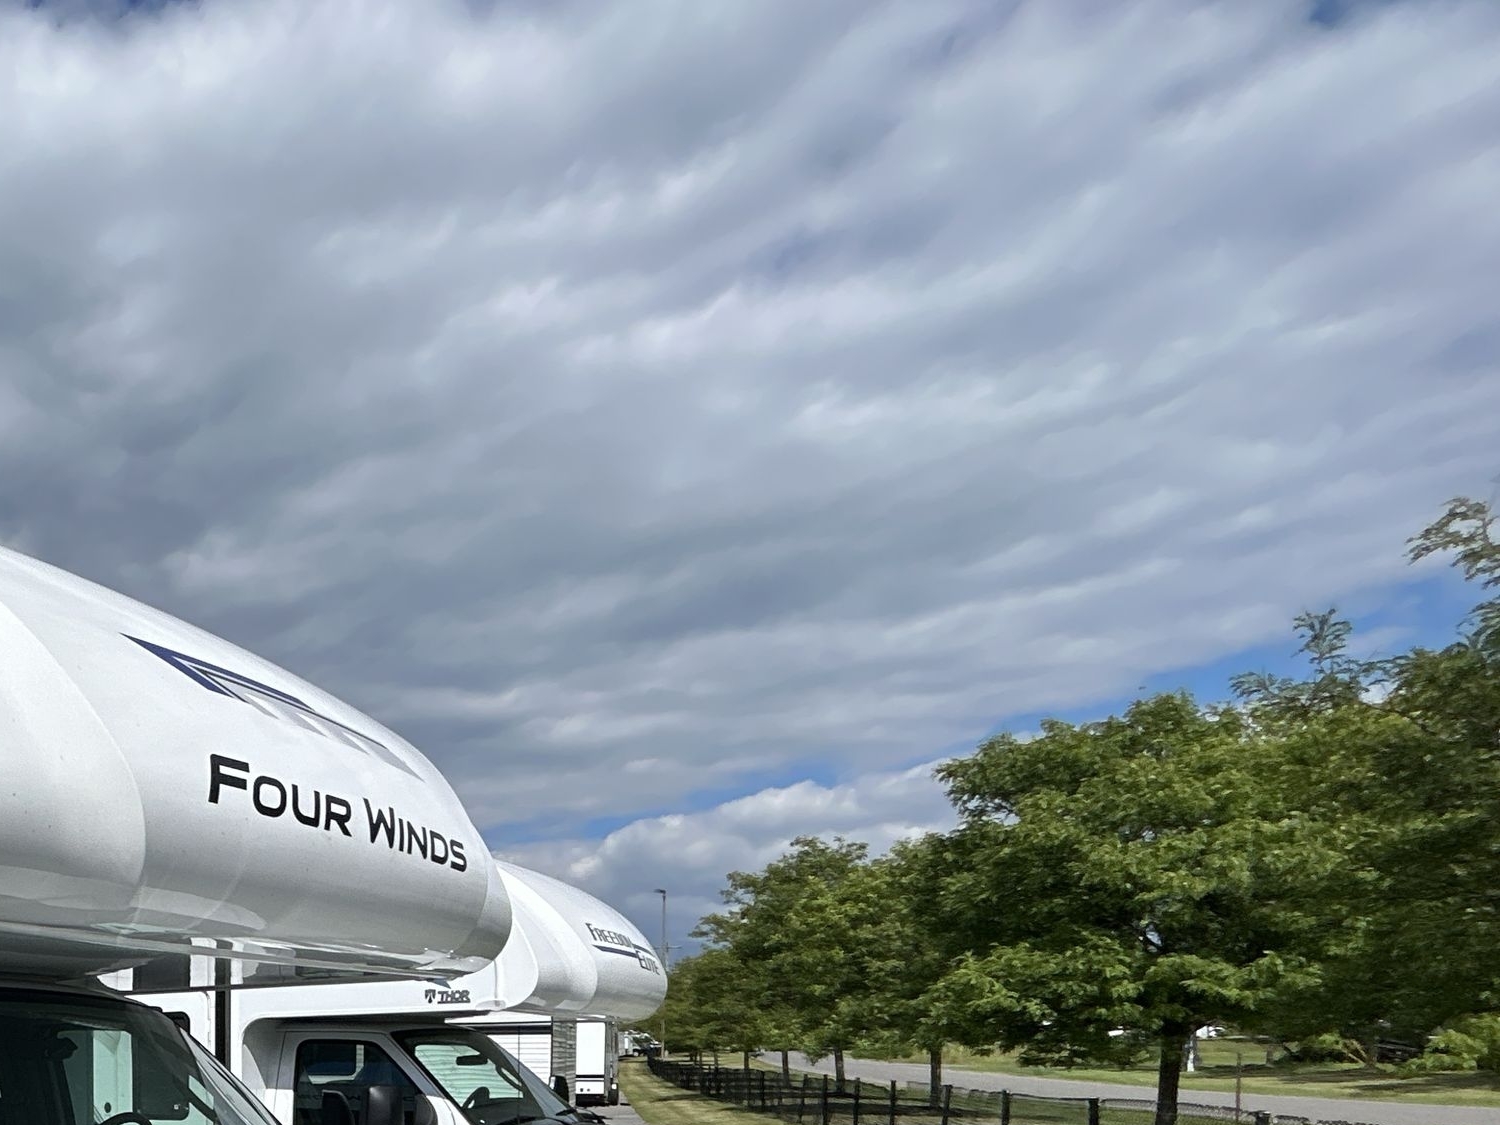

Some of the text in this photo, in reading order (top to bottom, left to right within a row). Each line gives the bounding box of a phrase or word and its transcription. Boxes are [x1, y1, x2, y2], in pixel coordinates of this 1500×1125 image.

[208, 753, 467, 872] FOUR WINDS
[437, 989, 471, 1002] THOR
